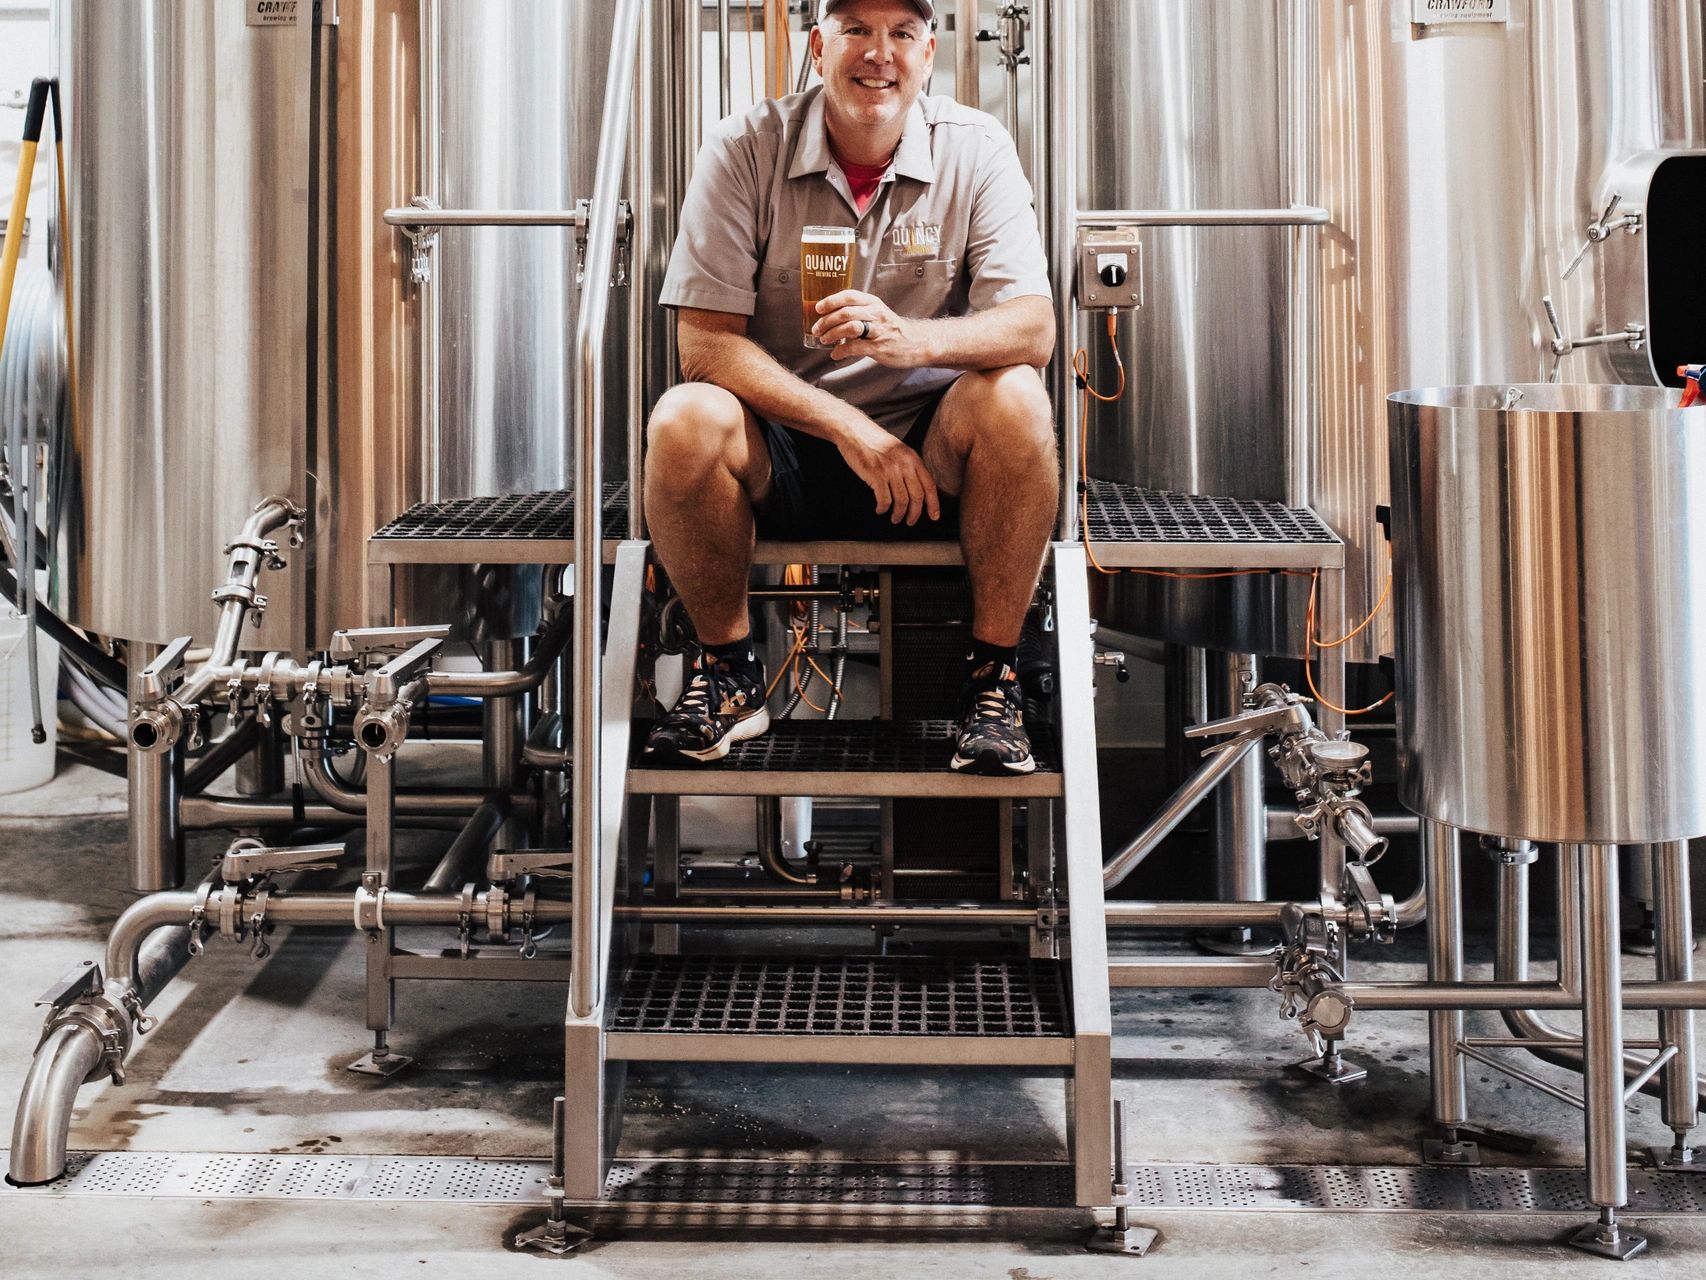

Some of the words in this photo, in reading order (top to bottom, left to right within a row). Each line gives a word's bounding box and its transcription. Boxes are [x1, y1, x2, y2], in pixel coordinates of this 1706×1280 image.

[257, 1, 321, 13] CRAWFD
[892, 224, 942, 246] QUINCY
[805, 254, 849, 271] QUINCY
